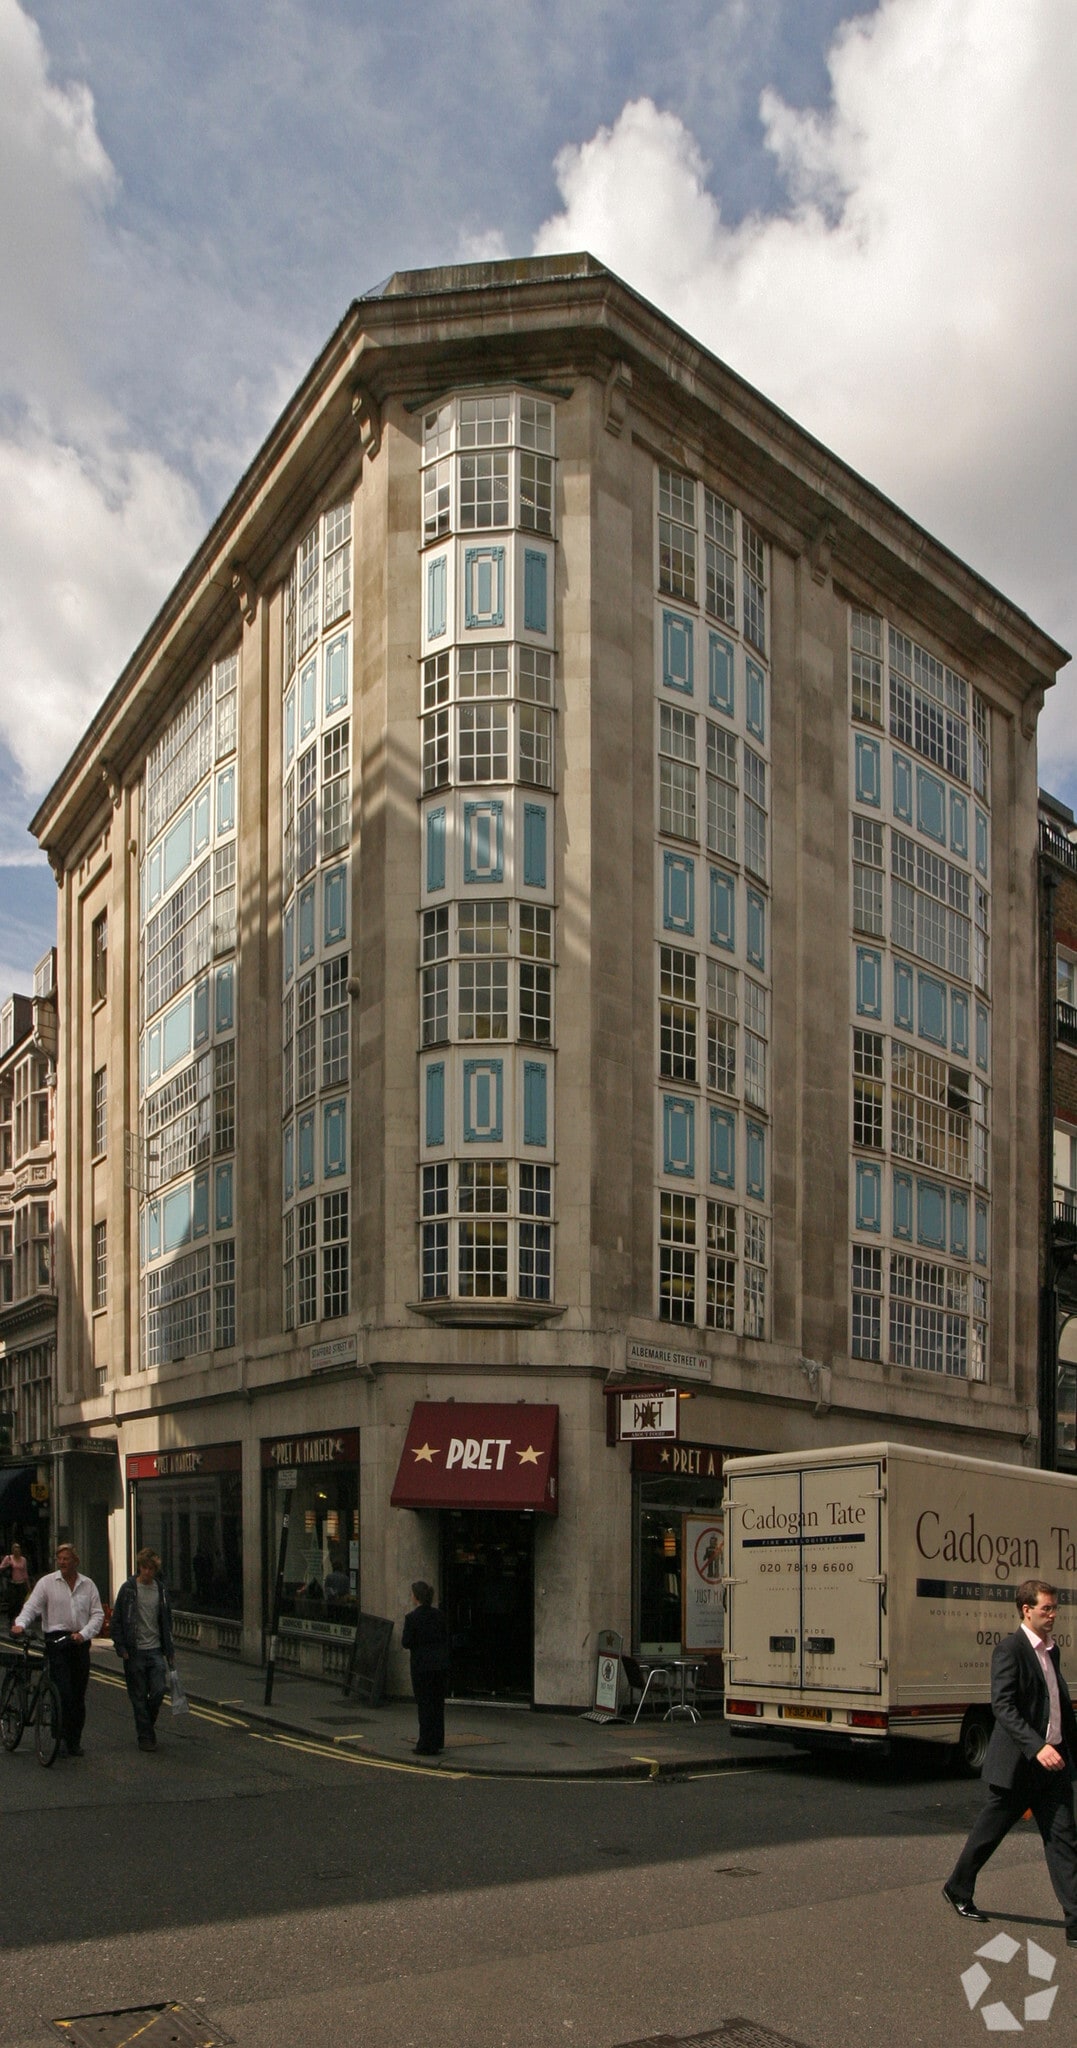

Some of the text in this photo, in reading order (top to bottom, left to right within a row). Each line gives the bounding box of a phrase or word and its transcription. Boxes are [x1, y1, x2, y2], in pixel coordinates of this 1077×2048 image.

[631, 1346, 708, 1369] ALBEMARLE STREET W1
[276, 1437, 335, 1465] PRET A MANGER
[446, 1438, 512, 1470] PRET
[673, 1447, 716, 1476] PRET A
[741, 1502, 866, 1535] Cadogan Tate
[915, 1510, 1040, 1581] Cadogan
[760, 1562, 854, 1573] 020 7819 6600
[952, 1585, 981, 1597] FINE
[988, 1586, 1013, 1598] ART
[929, 1609, 962, 1617] MOVING
[976, 1630, 1001, 1646] 020
